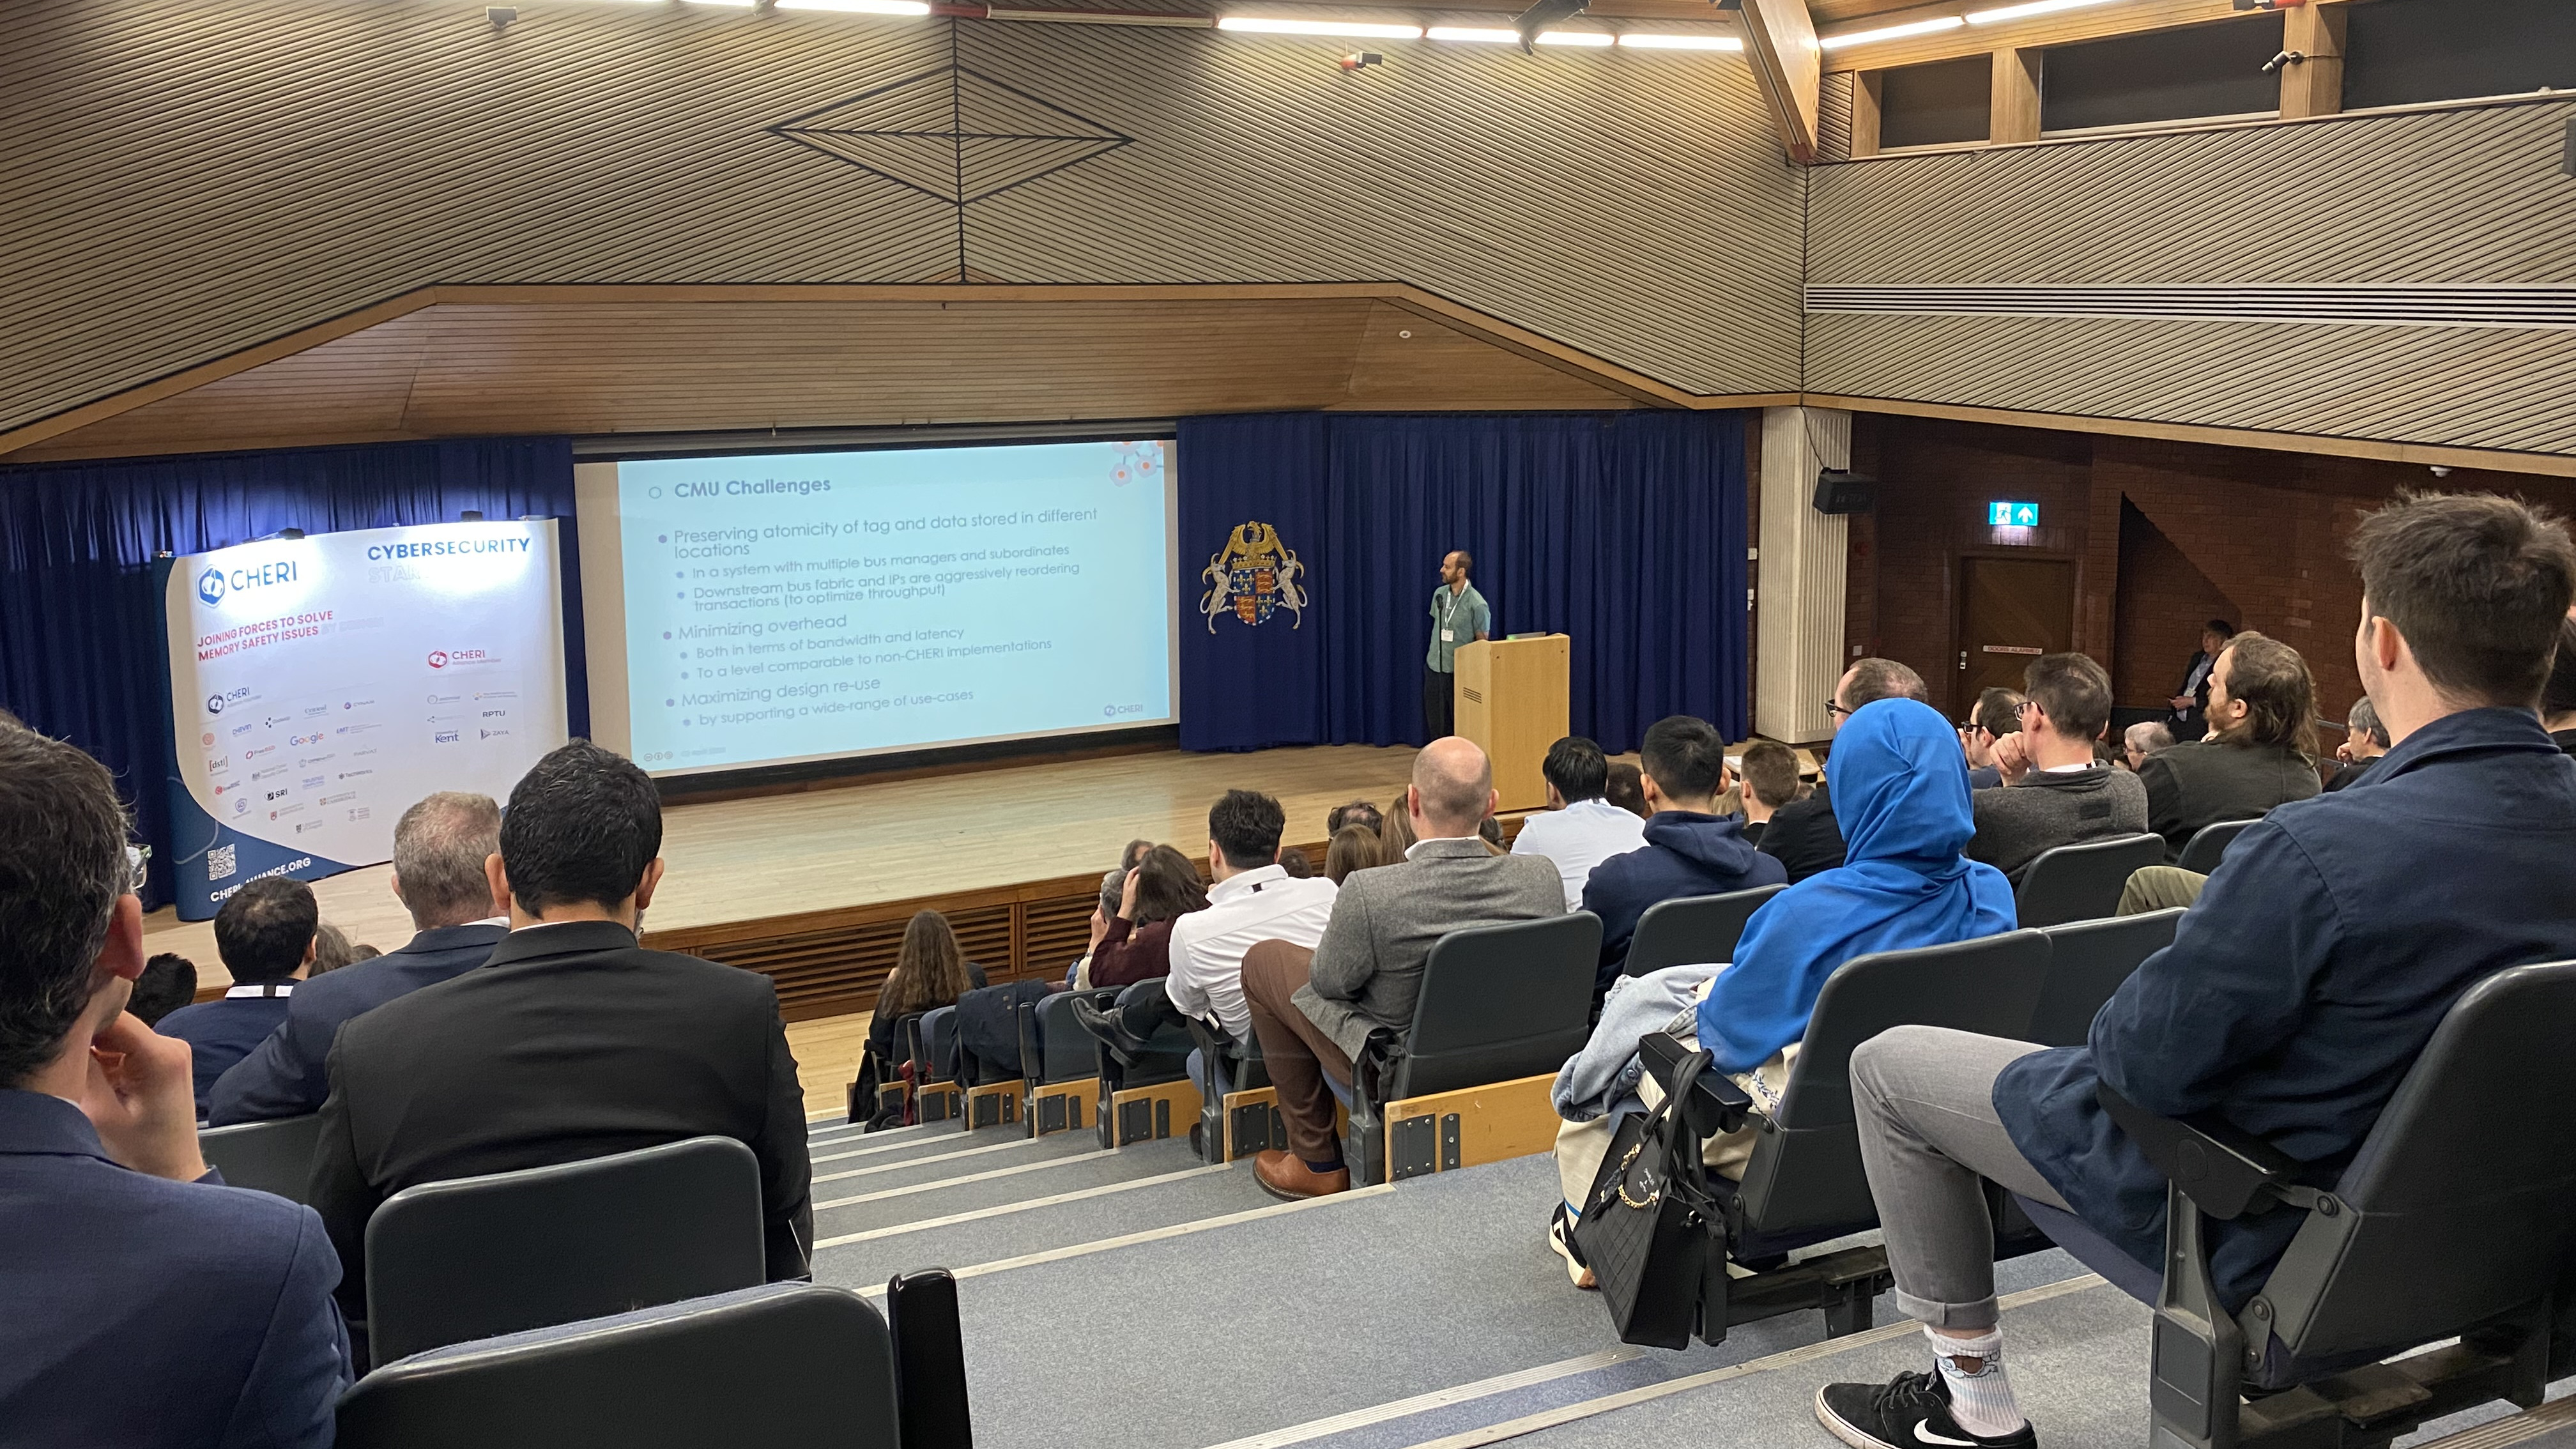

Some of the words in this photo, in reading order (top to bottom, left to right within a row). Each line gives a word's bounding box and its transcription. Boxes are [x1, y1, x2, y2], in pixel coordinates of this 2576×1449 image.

[674, 481, 719, 498] CMU
[726, 479, 831, 496] Challenges
[675, 526, 758, 543] Preserving
[763, 522, 838, 538] atomicity
[843, 519, 858, 533] of
[863, 519, 890, 534] tag
[895, 517, 926, 531] and
[931, 514, 967, 529] data
[971, 512, 1017, 527] stored
[1022, 510, 1033, 524] in
[1038, 508, 1098, 523] different
[367, 537, 530, 561] CYBERSECURITY
[675, 543, 750, 559] locations
[693, 568, 705, 578] In
[709, 568, 719, 578] a
[723, 564, 770, 579] system
[774, 560, 802, 573] with
[807, 556, 860, 572] multiple
[864, 556, 887, 568] bus
[891, 553, 956, 565] managers
[960, 549, 986, 562] and
[990, 545, 1070, 559] subordinates
[231, 560, 297, 591] CHERI
[694, 584, 783, 599] Downstream
[787, 581, 811, 592] bus
[815, 577, 854, 590] fabric
[858, 574, 885, 587] and
[889, 573, 905, 585] IPs
[909, 574, 931, 583] are
[935, 567, 1012, 583] aggressively
[1016, 563, 1080, 576] reordering
[695, 595, 779, 611] transactions
[785, 592, 802, 607] (to
[807, 590, 863, 604] optimize
[868, 583, 946, 601] throughput)
[197, 629, 237, 647] JOINING
[239, 620, 278, 637] FORCES
[279, 617, 295, 627] TO
[297, 610, 333, 624] SOLVE
[678, 622, 763, 640] Minimizing
[768, 615, 847, 632] overhead
[198, 641, 240, 661] MEMORY
[242, 632, 279, 650] SAFETY
[282, 625, 318, 641] ISSUES
[452, 650, 485, 659] CHERI
[696, 645, 728, 659] Both
[732, 644, 744, 656] in
[749, 641, 785, 654] terms
[790, 638, 804, 651] of
[808, 632, 880, 650] bandwidth
[885, 630, 912, 643] and
[916, 628, 964, 642] latency
[697, 667, 713, 679] To
[717, 666, 727, 677] a
[731, 662, 764, 675] level
[768, 656, 854, 673] comparable
[858, 653, 871, 665] to
[875, 647, 944, 664] non-CHERI
[947, 639, 1052, 659] implementations
[227, 687, 250, 702] CHERI
[682, 687, 771, 707] Maximizing
[777, 684, 829, 698] design
[834, 678, 880, 693] re-use
[700, 713, 717, 727] by
[721, 706, 795, 724] supporting
[799, 705, 808, 716] a
[812, 698, 890, 716] wide-range
[894, 694, 907, 707] of
[910, 690, 974, 705] use-cases
[1117, 704, 1143, 714] CHERI
[290, 731, 324, 746] Google
[435, 733, 459, 743] Kent
[275, 788, 288, 798] SRI
